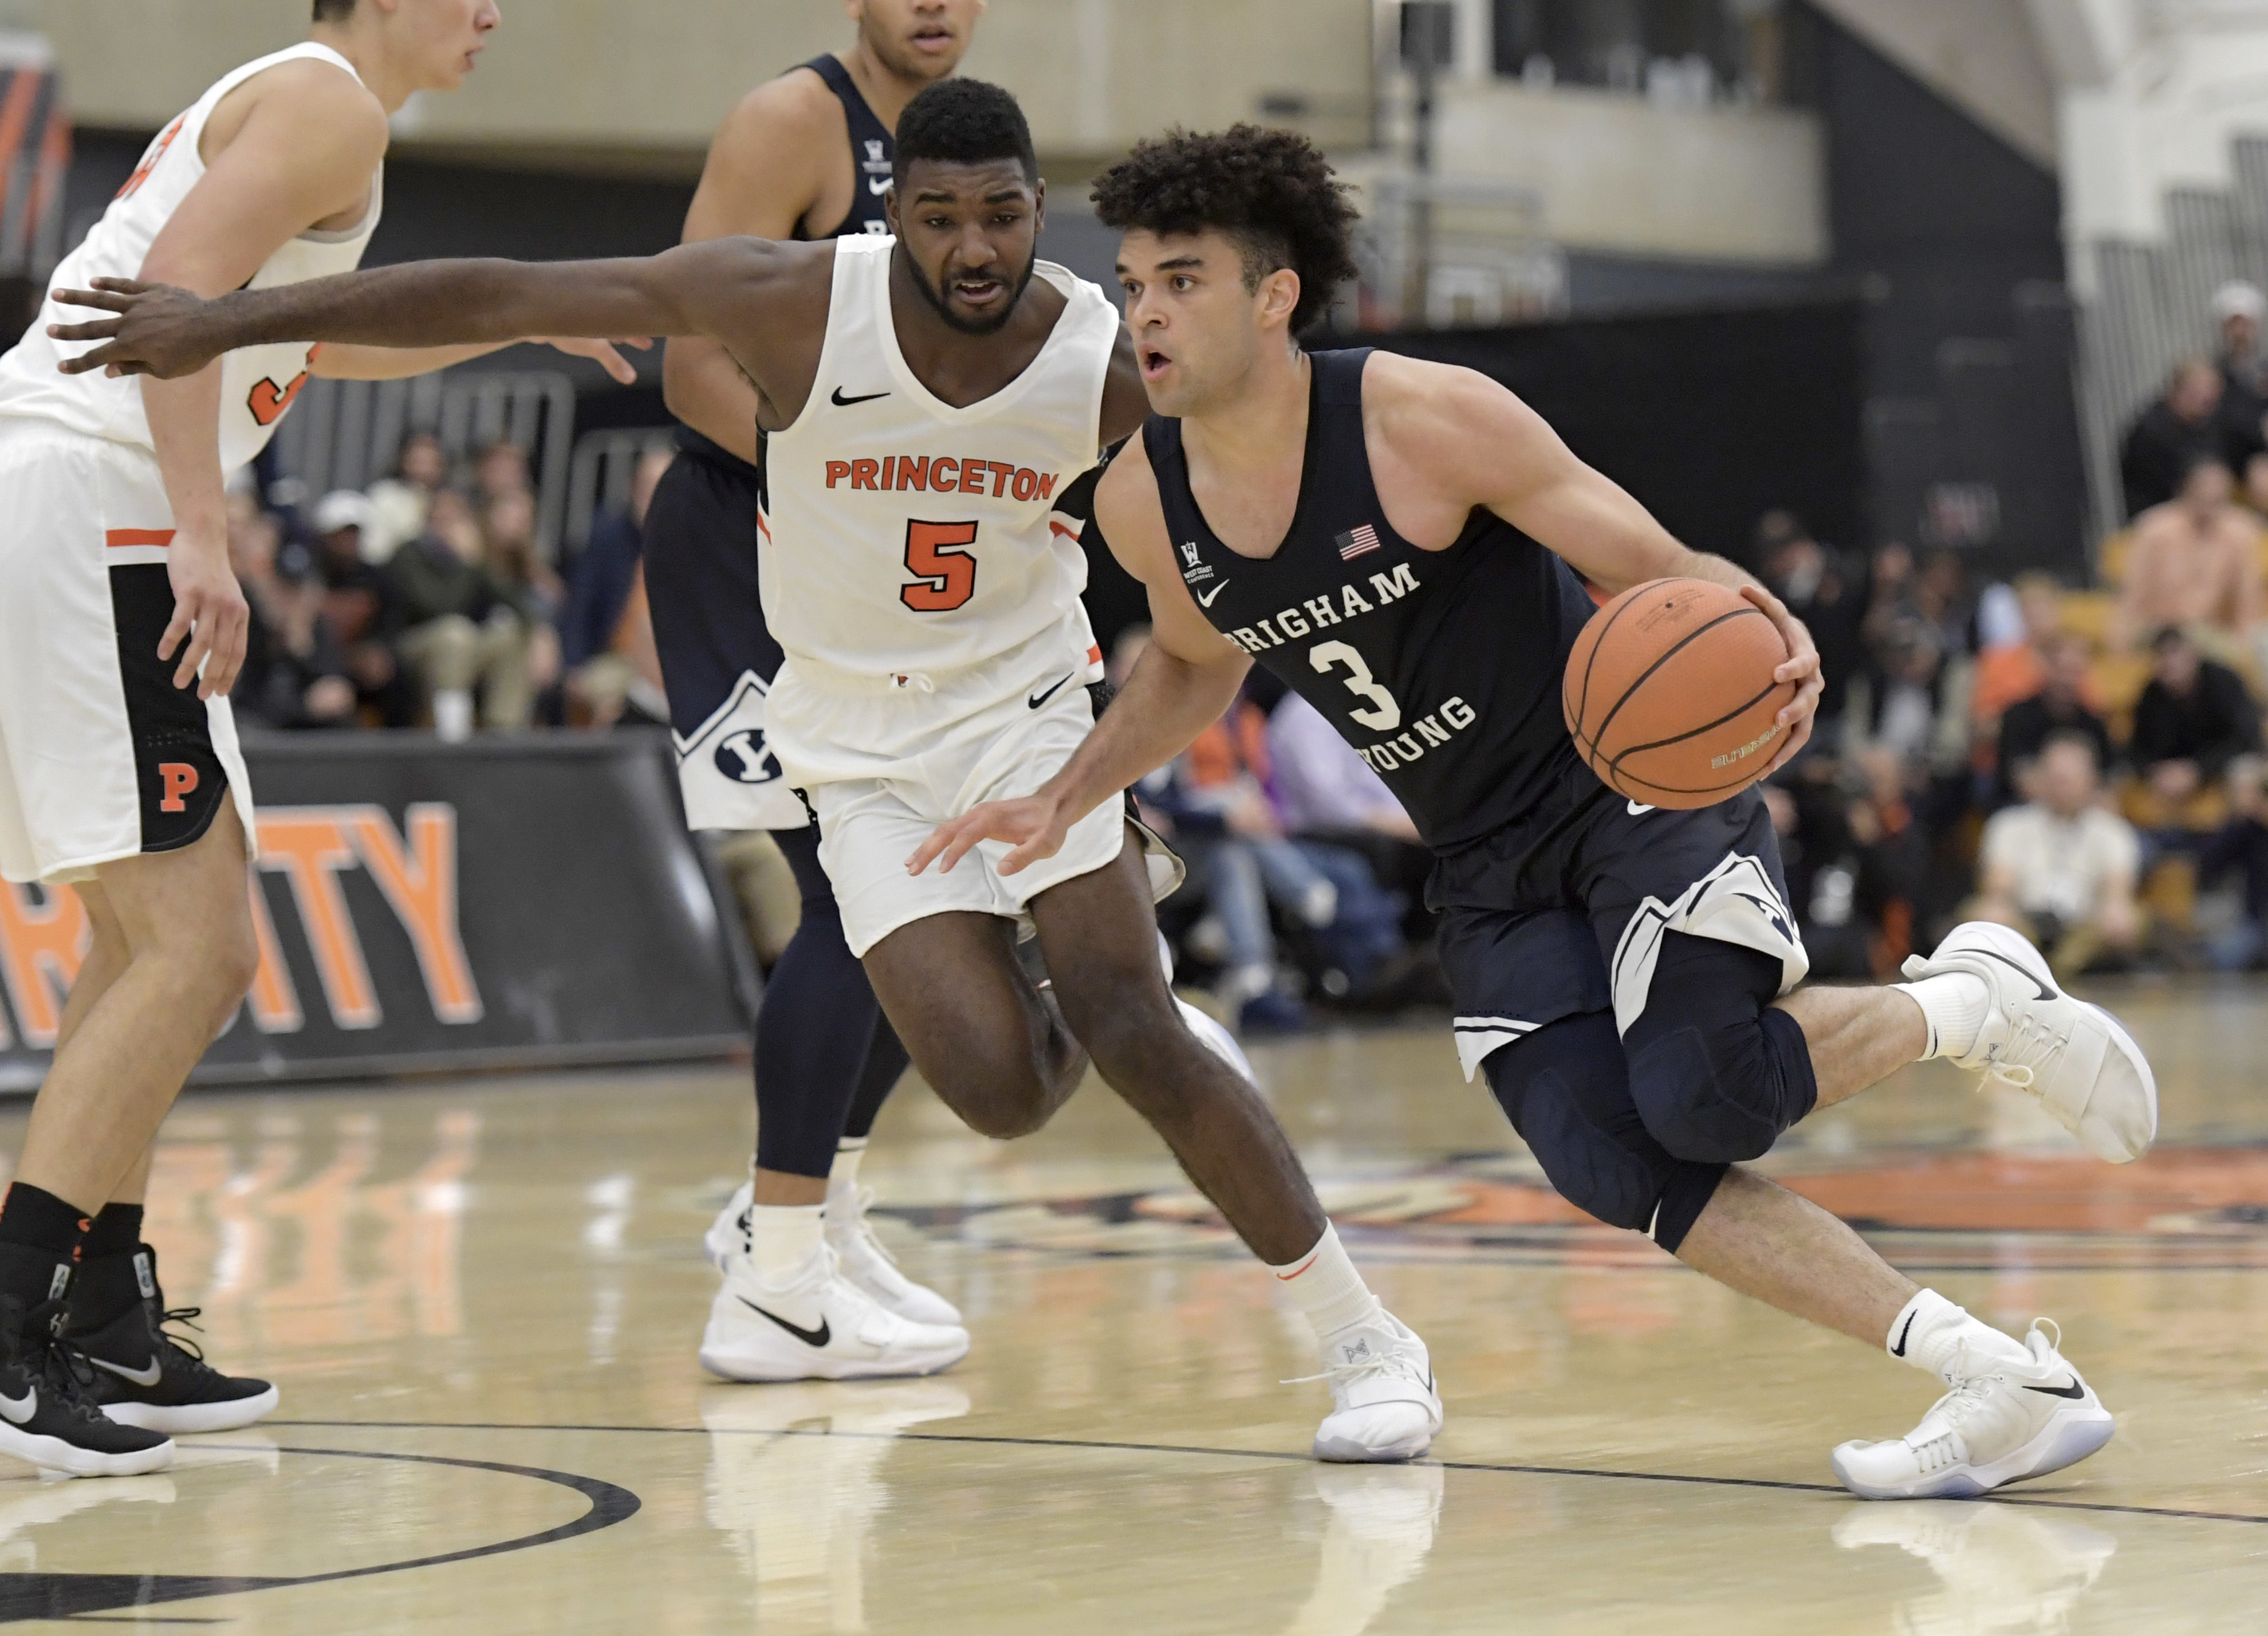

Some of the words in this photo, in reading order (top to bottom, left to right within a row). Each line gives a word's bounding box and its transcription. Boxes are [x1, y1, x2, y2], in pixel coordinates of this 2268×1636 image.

[826, 456, 1059, 501] PRINCETON
[900, 518, 979, 612] 5
[1183, 568, 1197, 579] WEST
[1196, 565, 1212, 574] COAST
[1309, 640, 1401, 731] 3
[159, 762, 199, 812] P
